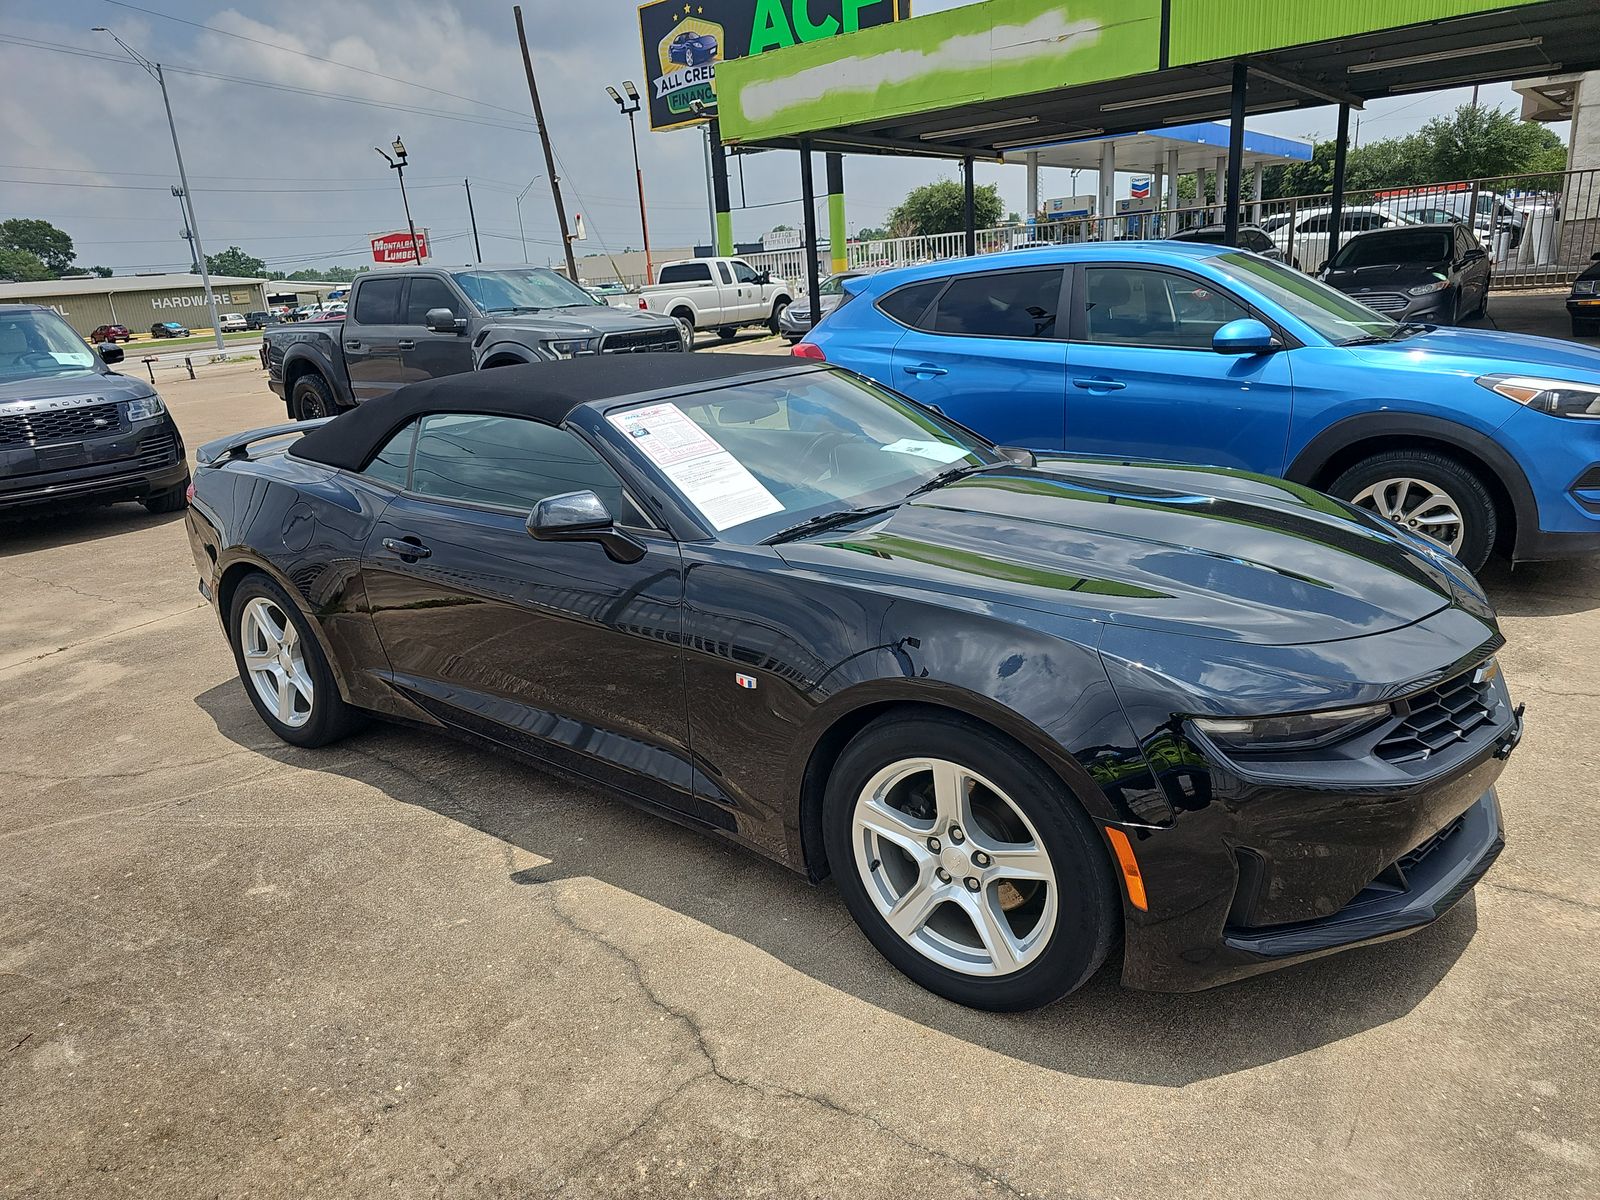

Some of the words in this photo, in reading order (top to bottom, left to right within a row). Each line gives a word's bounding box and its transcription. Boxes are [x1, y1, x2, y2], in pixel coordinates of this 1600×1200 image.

[661, 74, 682, 93] ALL
[373, 239, 424, 251] MONTALBAO
[49, 395, 105, 408] ROVER
